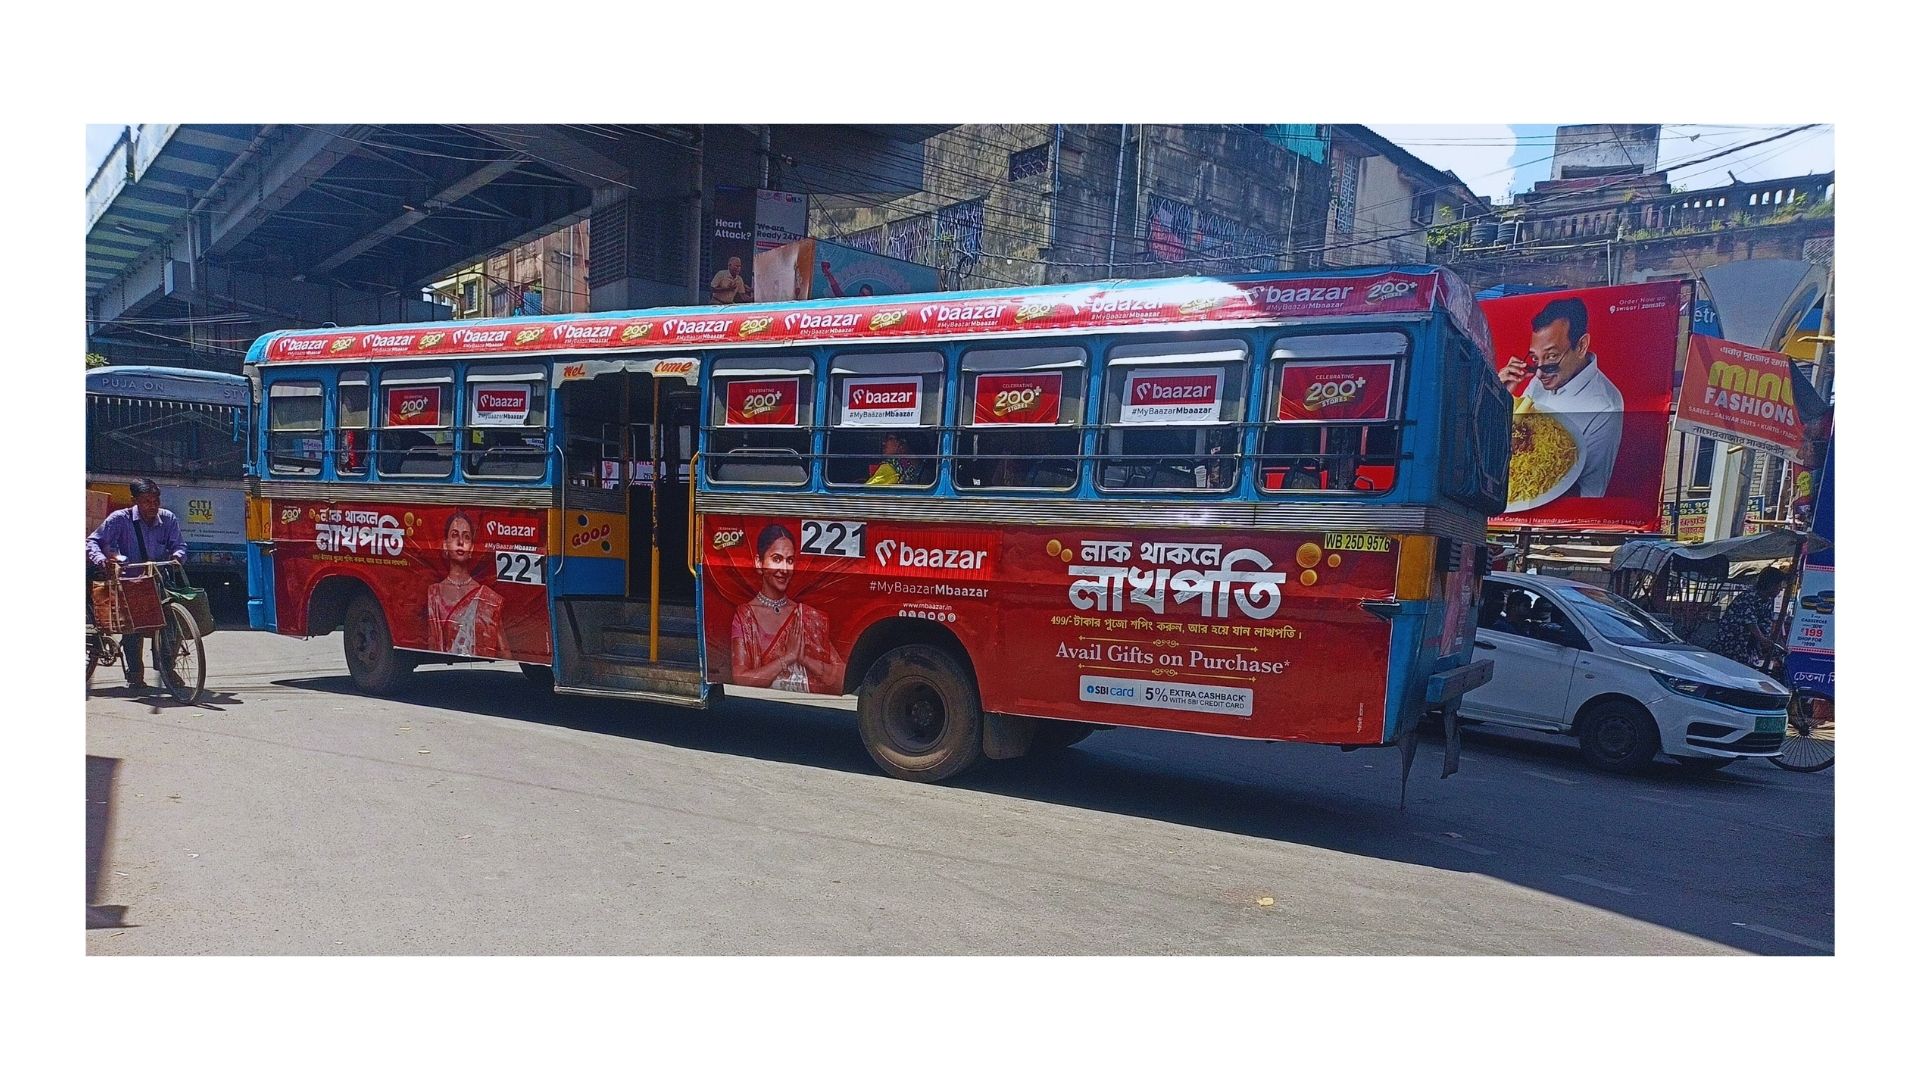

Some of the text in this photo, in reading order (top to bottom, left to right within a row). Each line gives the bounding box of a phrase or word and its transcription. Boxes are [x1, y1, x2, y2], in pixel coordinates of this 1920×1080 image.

[715, 219, 742, 229] Heart
[714, 229, 752, 240] Attack?
[757, 232, 782, 241] Ready
[1368, 281, 1418, 299] 200+
[1266, 301, 1344, 311] #MyBaazarMbaazar
[1091, 311, 1160, 320] #MyBaazarMbaazar
[1693, 307, 1716, 324] etr
[102, 377, 164, 391] PUJA ON
[1306, 376, 1367, 402] 200+
[223, 388, 247, 399] STY
[744, 391, 782, 411] 200+
[995, 385, 1043, 408] 200+
[1321, 396, 1348, 407] STORES
[401, 396, 429, 414] 200+
[1131, 406, 1213, 417] #MyBaazarMbaazar
[1704, 387, 1796, 426] FASHIONS
[849, 409, 915, 419] #MyBaazarMbaazar
[188, 499, 212, 509] CITI
[281, 507, 302, 521] 200+
[344, 509, 379, 525] থাকলে
[315, 514, 405, 556] লাখপতি
[571, 523, 612, 549] GOOD
[714, 529, 744, 545] 200+
[801, 521, 867, 557] 221
[1325, 533, 1390, 551] WB 25D 9576
[1080, 540, 1223, 566] লাক থাকলে
[496, 552, 547, 585] 221
[868, 580, 990, 598] #MyBaazarMbaazar
[1067, 548, 1287, 620] লাখপতি
[902, 601, 953, 611] www.mbaazar.in
[1104, 618, 1128, 632] পুজো
[1131, 616, 1154, 631] শপিং
[1187, 623, 1209, 634] আর
[1212, 624, 1230, 636] হয়ে
[1232, 625, 1251, 637] যান
[1055, 641, 1102, 661] Avail
[1107, 644, 1154, 665] Gifts
[1159, 653, 1184, 666] on
[1793, 671, 1826, 684] চেতনা
[1095, 685, 1135, 698] SBI card
[1145, 687, 1169, 703] 5%
[1169, 688, 1197, 699] EXTRA
[1200, 699, 1224, 708] CREDIT
[1225, 701, 1245, 710] CARD
